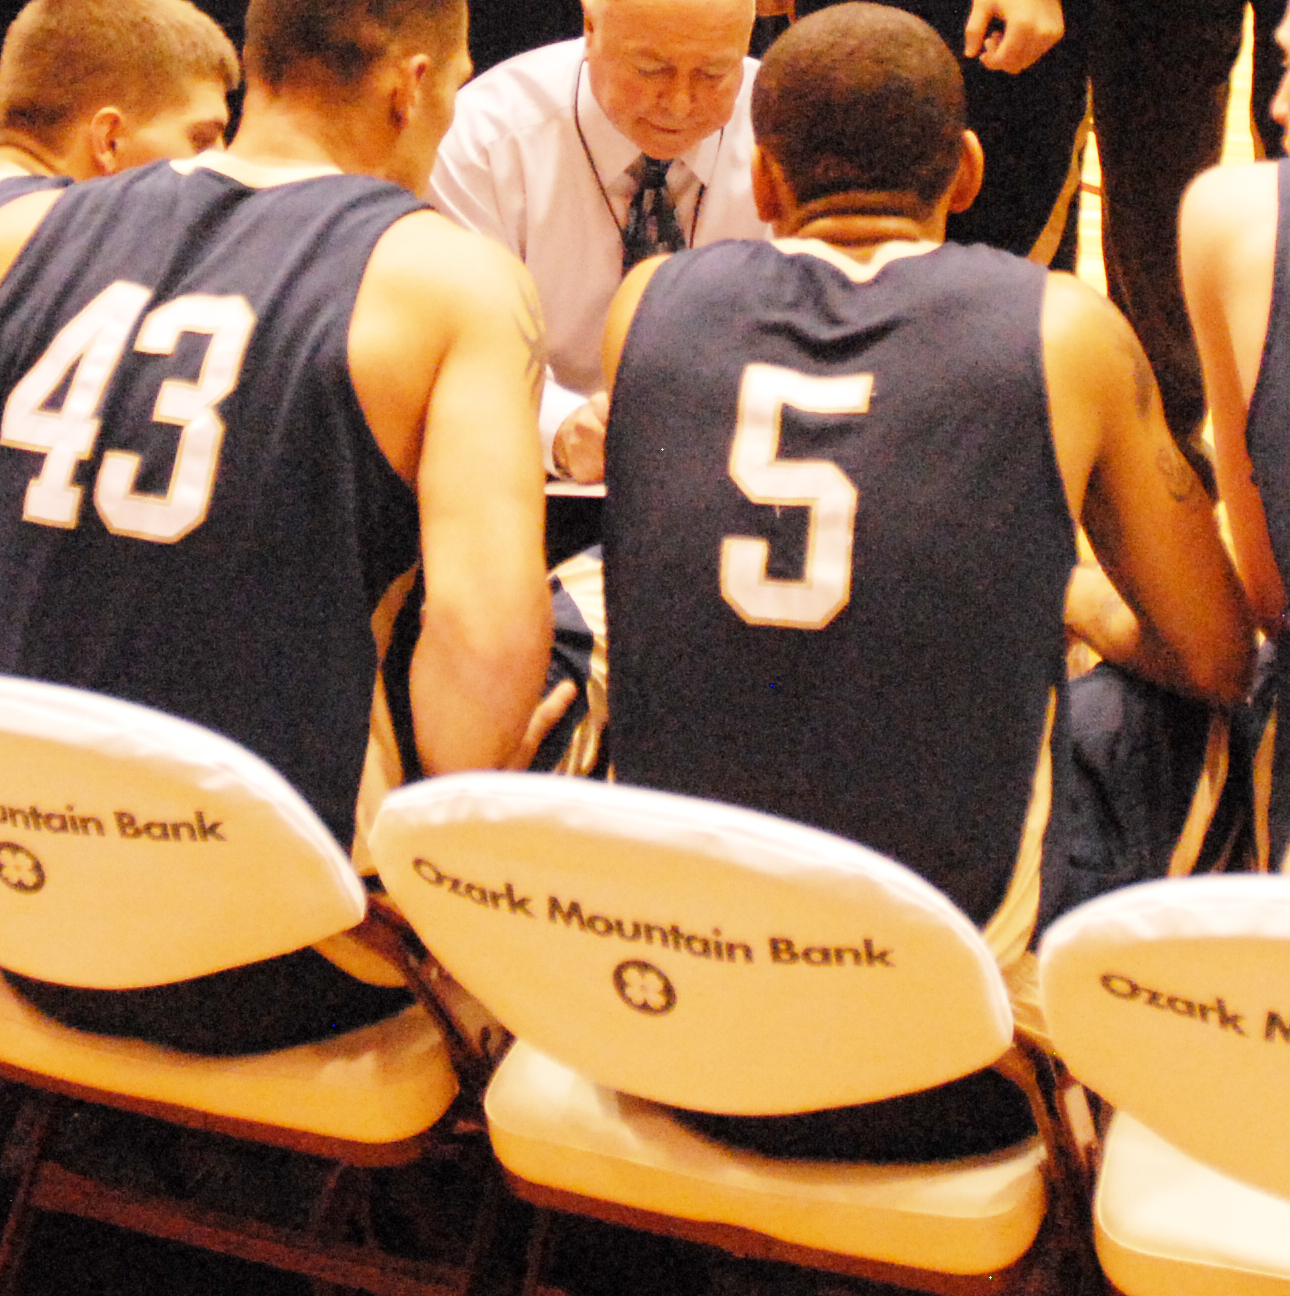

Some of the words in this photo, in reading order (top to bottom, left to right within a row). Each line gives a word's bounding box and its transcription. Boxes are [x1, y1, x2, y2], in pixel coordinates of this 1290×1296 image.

[719, 361, 877, 633] 5
[115, 806, 228, 848] Bank
[412, 853, 533, 919] Ozark
[546, 898, 756, 965] Mountain
[766, 932, 897, 972] Bank
[1099, 968, 1248, 1039] Ozark
